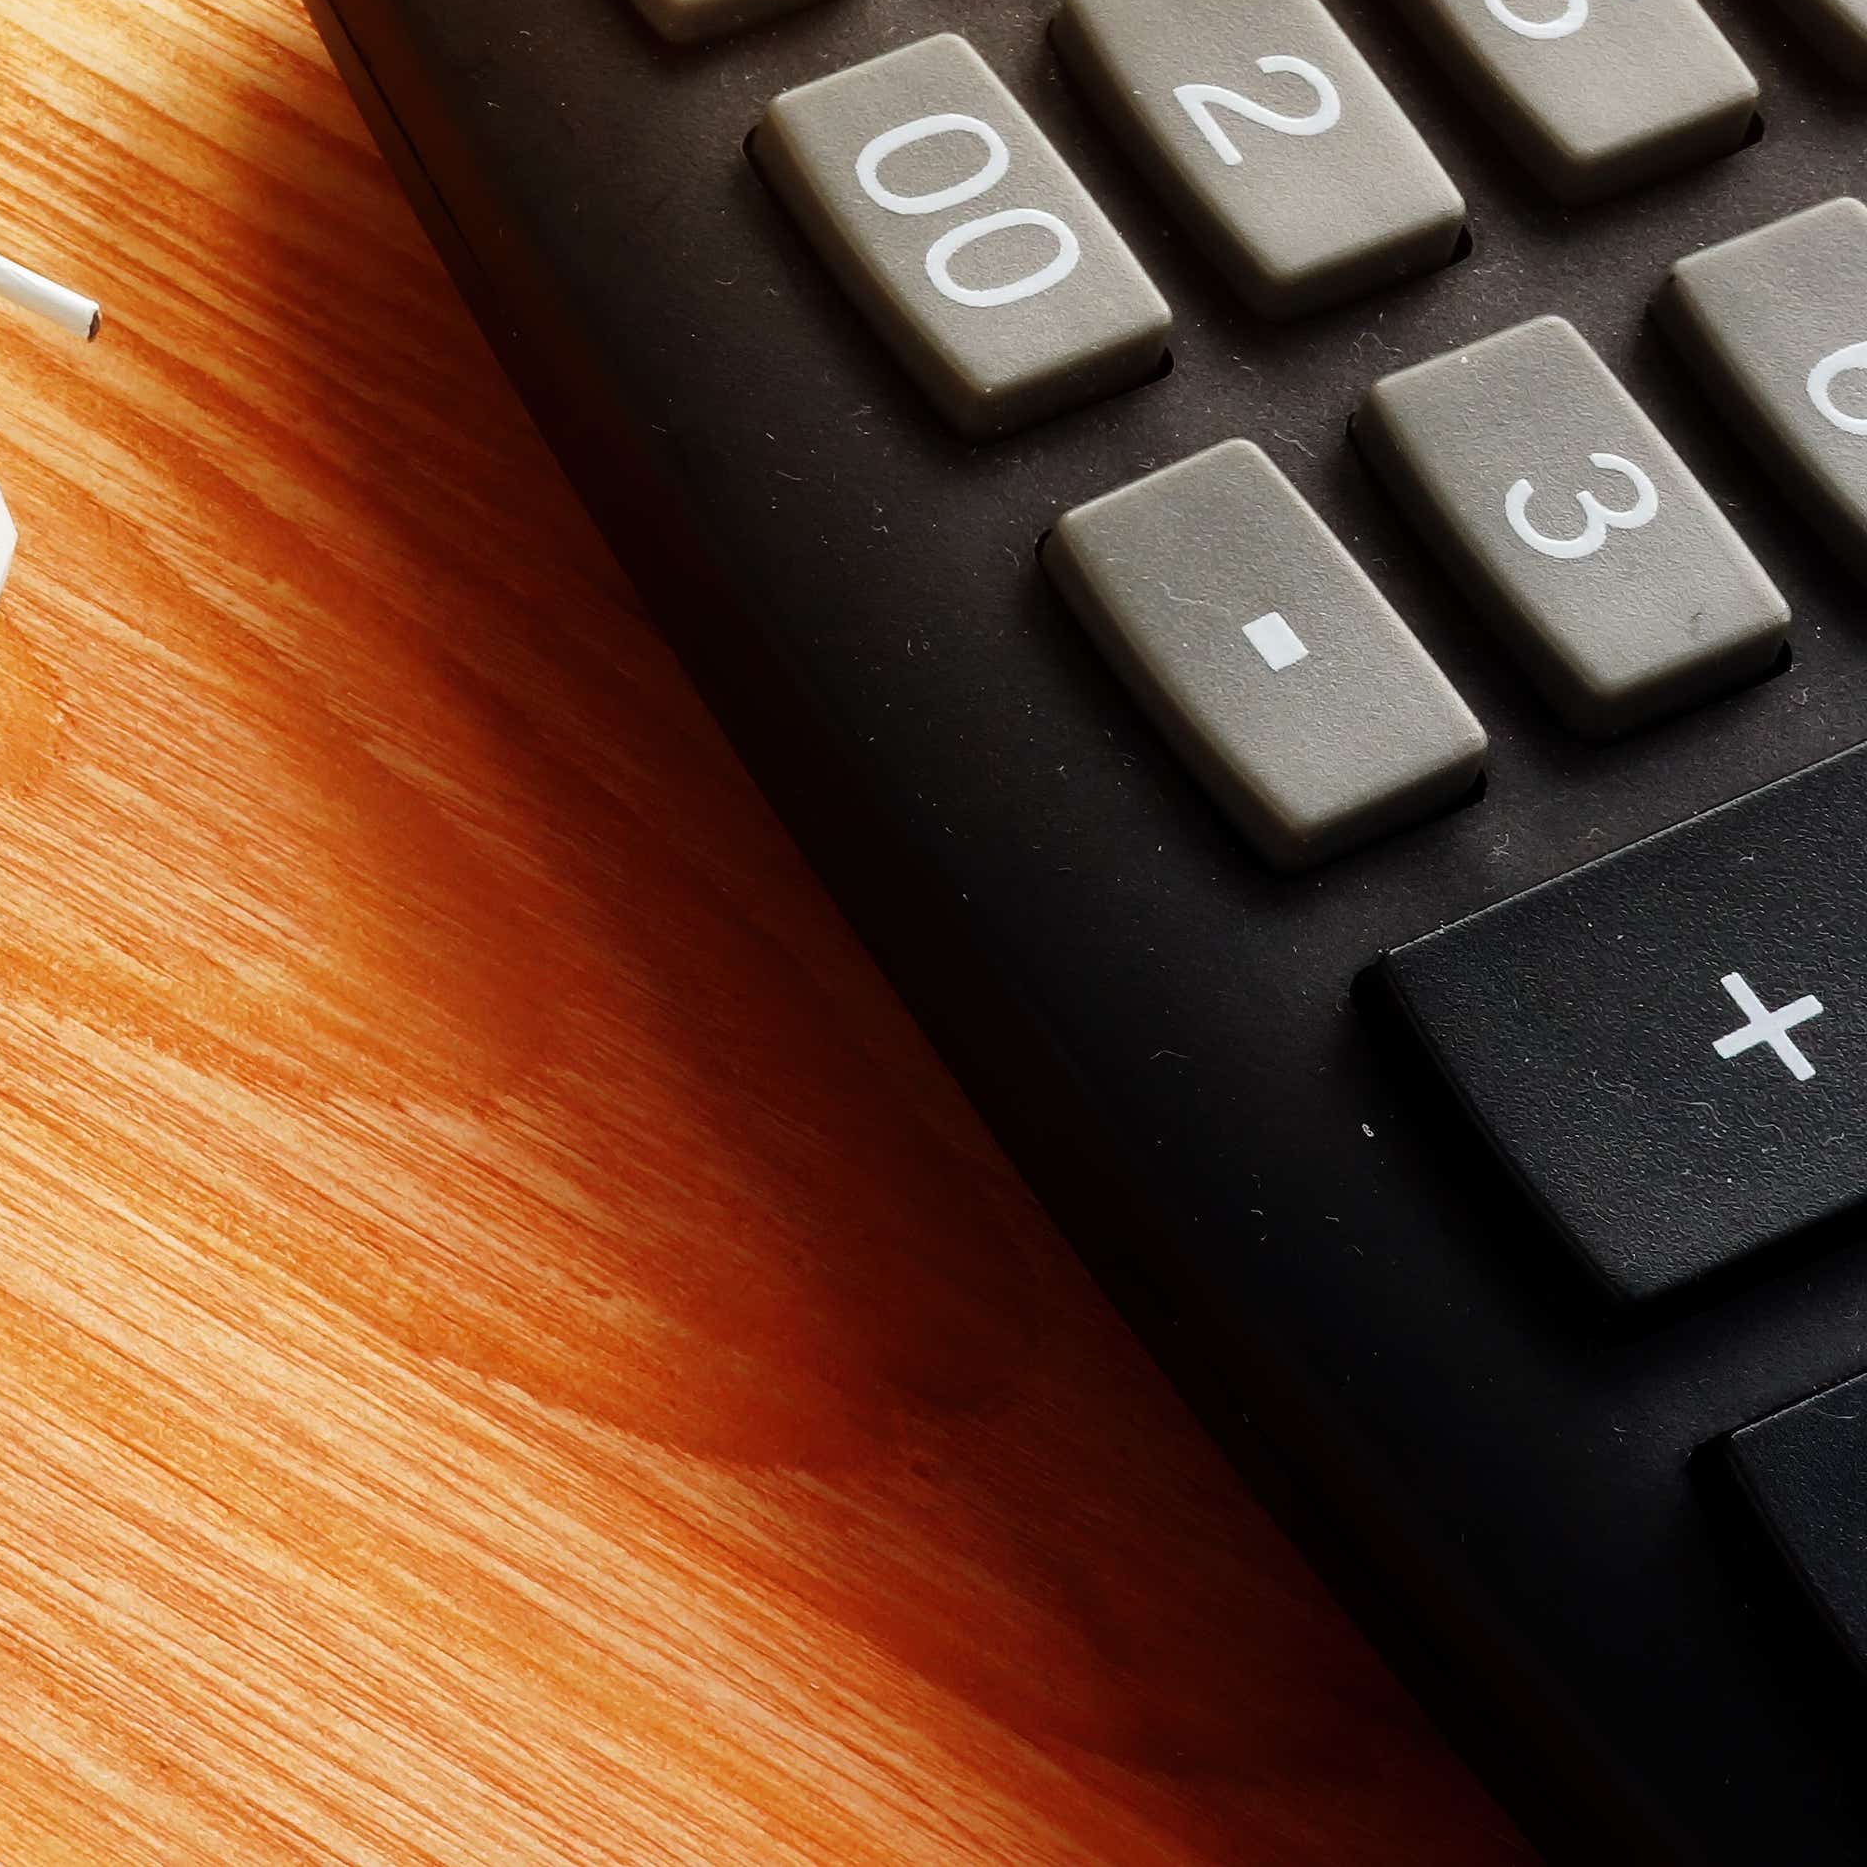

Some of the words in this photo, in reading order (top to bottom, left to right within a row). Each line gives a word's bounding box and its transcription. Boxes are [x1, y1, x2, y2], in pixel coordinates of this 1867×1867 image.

[1172, 55, 1342, 166] 2
[855, 113, 1081, 308] 00
[1504, 452, 1659, 560] 3
